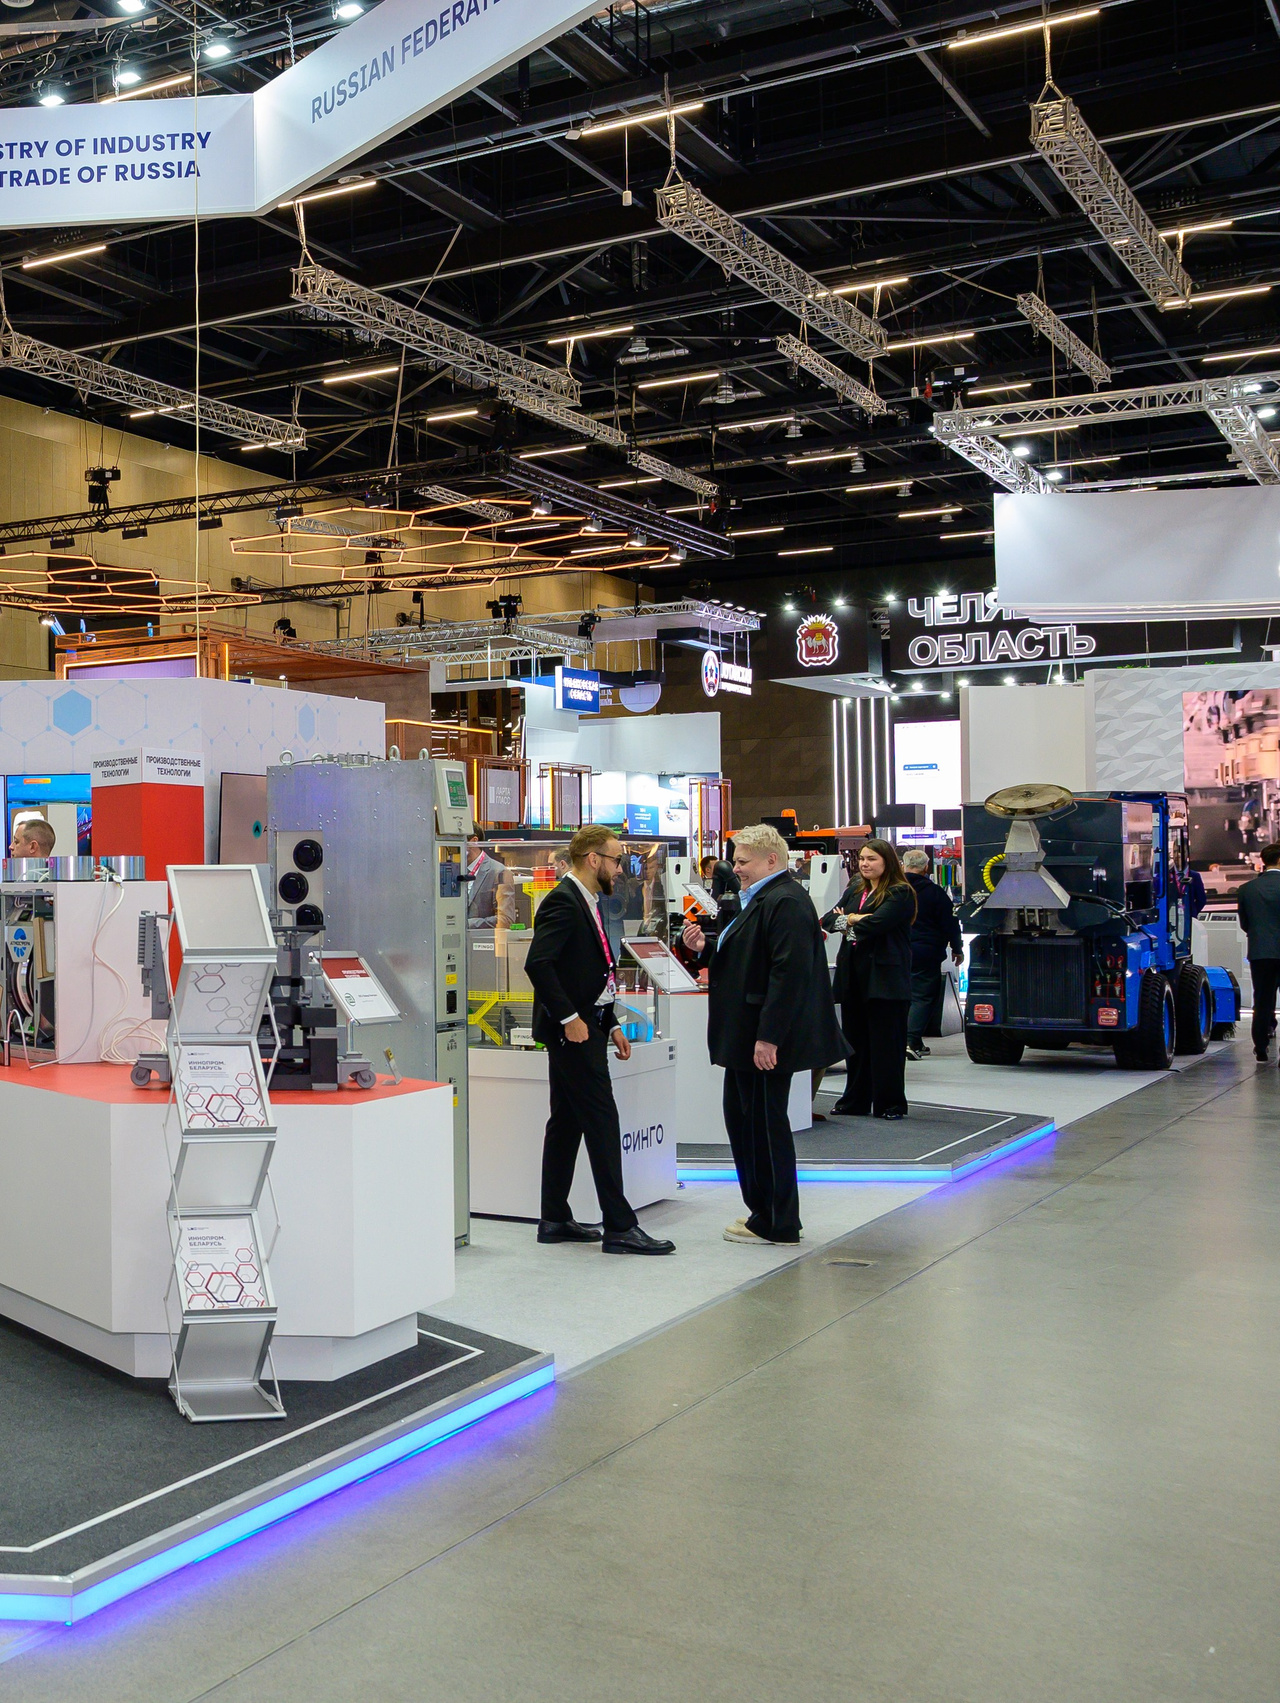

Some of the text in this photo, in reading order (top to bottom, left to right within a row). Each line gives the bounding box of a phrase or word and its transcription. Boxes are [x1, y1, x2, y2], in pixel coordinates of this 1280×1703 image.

[311, 46, 395, 124] RUSSIAN
[55, 138, 86, 157] OF
[92, 131, 213, 154] INDUSTRY
[77, 165, 109, 184] OF
[115, 160, 202, 182] RUSSIA
[908, 625, 1096, 667] ОБЛАСТЬ
[93, 756, 138, 768] ПРОИЗВОДСТВЕННЫЕ
[101, 769, 129, 778] ТЕХНОЛОГИИ
[146, 756, 201, 767] ПРОИЗВОДСТВЕННЫЕ
[157, 767, 191, 777] ТЕХНОЛОГИИ
[622, 1124, 664, 1154] ФИНГО
